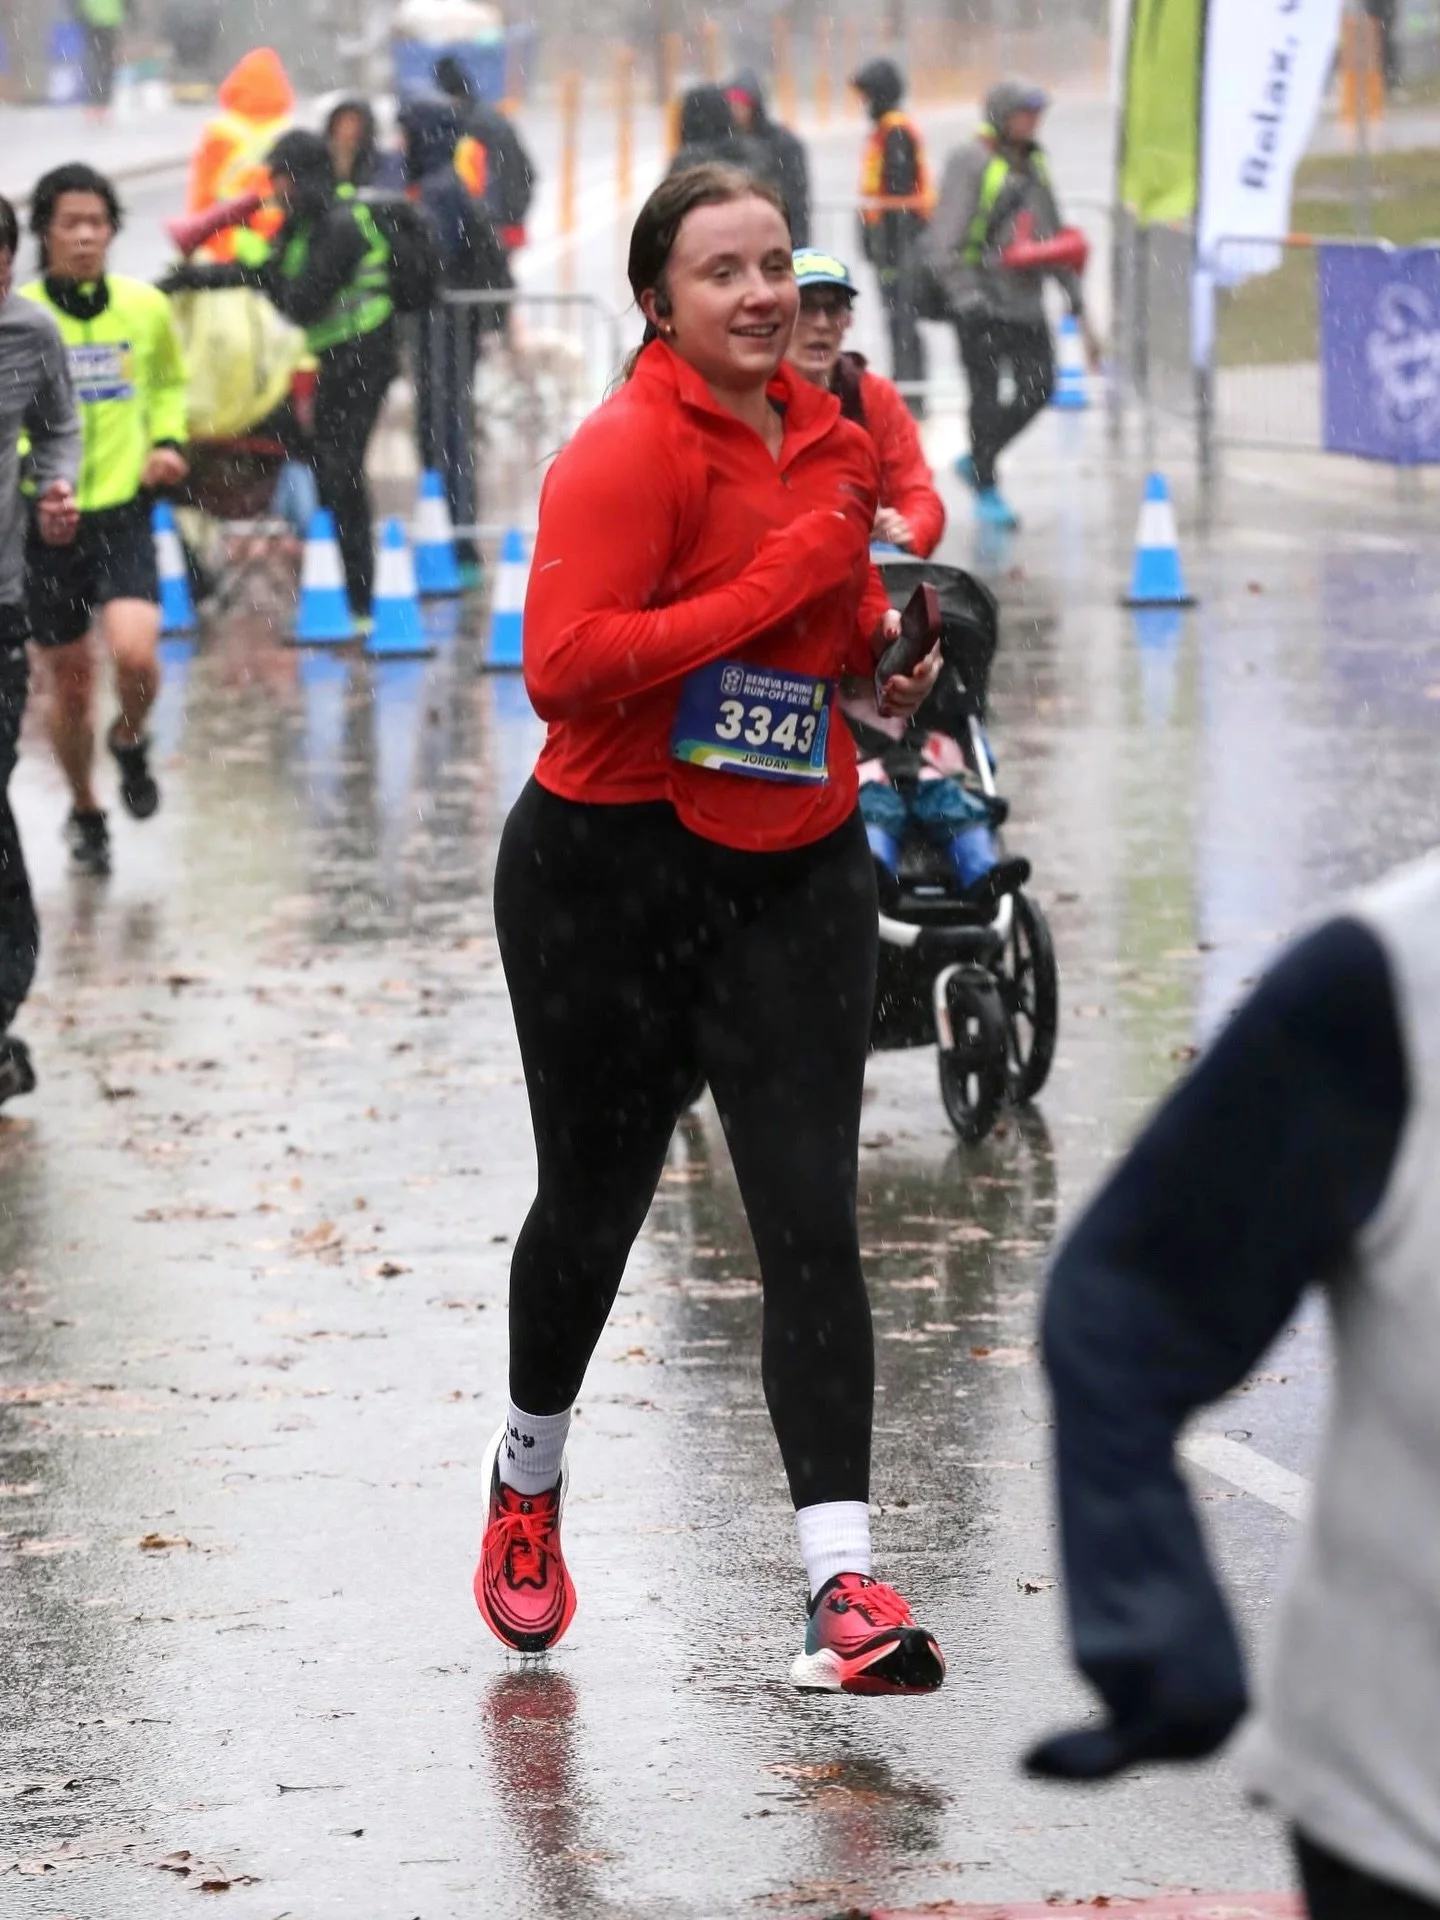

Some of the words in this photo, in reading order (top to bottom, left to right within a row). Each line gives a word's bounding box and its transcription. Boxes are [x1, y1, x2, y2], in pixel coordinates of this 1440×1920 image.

[743, 684, 786, 701] RUN-OFF
[715, 700, 816, 753] 3343
[742, 754, 788, 770] JORDAN
